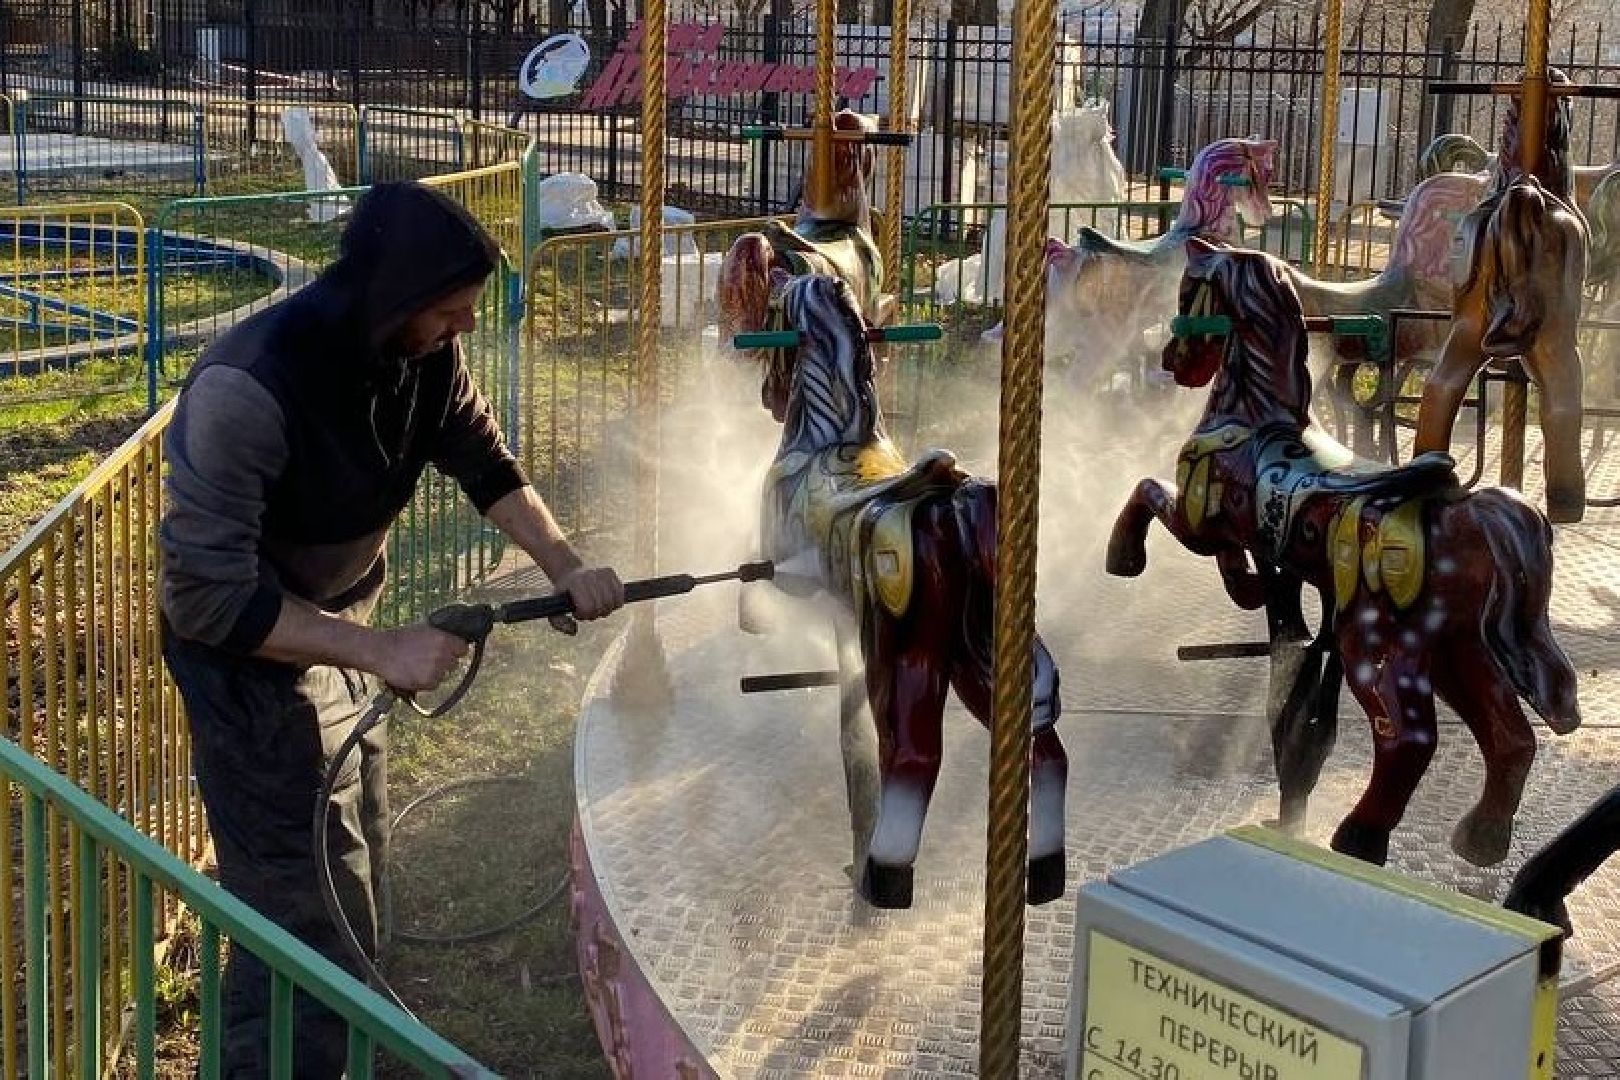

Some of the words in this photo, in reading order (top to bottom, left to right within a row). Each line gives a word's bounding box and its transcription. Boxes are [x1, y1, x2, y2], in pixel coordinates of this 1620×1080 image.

[1128, 958, 1319, 1065] ТЕХНИЧЕСКИЙ
[1087, 1026, 1103, 1050] С
[1113, 1038, 1181, 1080] 14.30
[1159, 1014, 1279, 1080] ПЕРЕРЫВ
